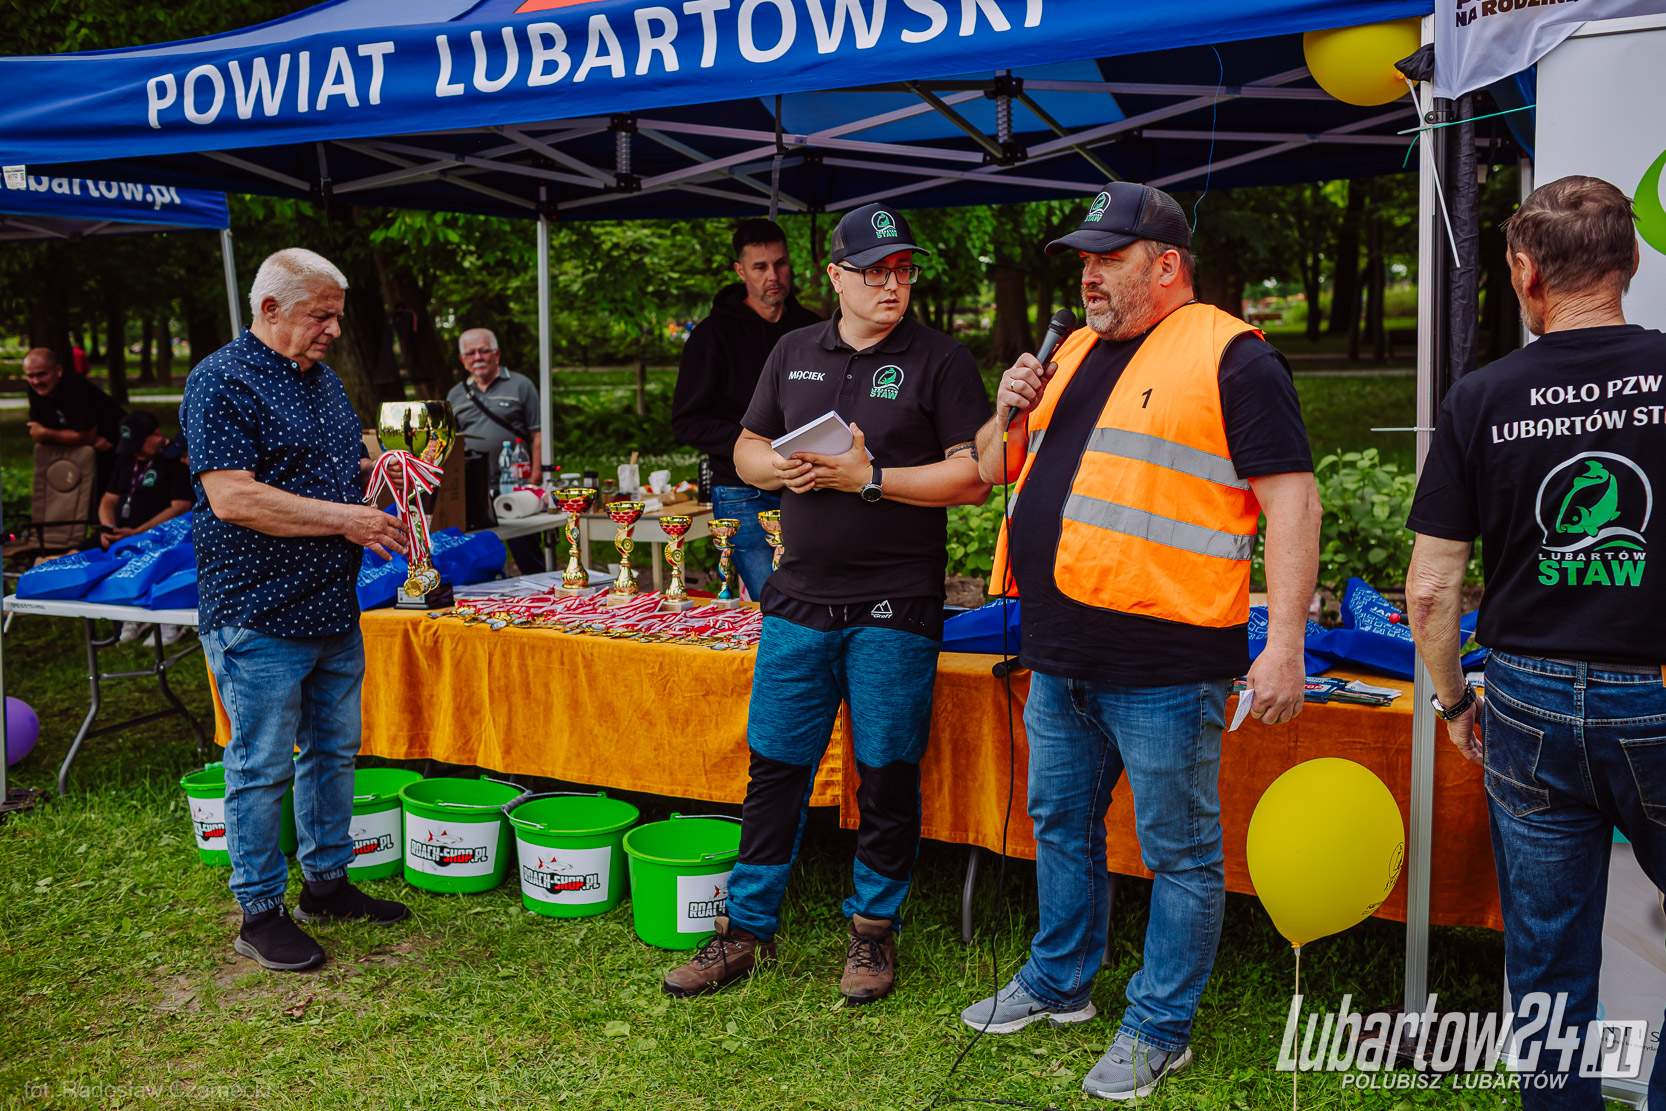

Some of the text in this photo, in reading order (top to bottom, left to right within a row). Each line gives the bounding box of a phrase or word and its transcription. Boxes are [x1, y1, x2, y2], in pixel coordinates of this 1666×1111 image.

[146, 41, 396, 128] POWIAT
[788, 370, 826, 381] MACIEK
[1142, 388, 1153, 409] 1
[1530, 375, 1663, 406] KOŁO PZW
[1491, 405, 1666, 444] LUBARTÓW ST
[1538, 550, 1647, 560] LUBARTÓW
[1538, 559, 1647, 587] STAW
[410, 839, 488, 866] ROACH-SHOP.PL
[522, 865, 600, 893] ROACH-SHOP.PL
